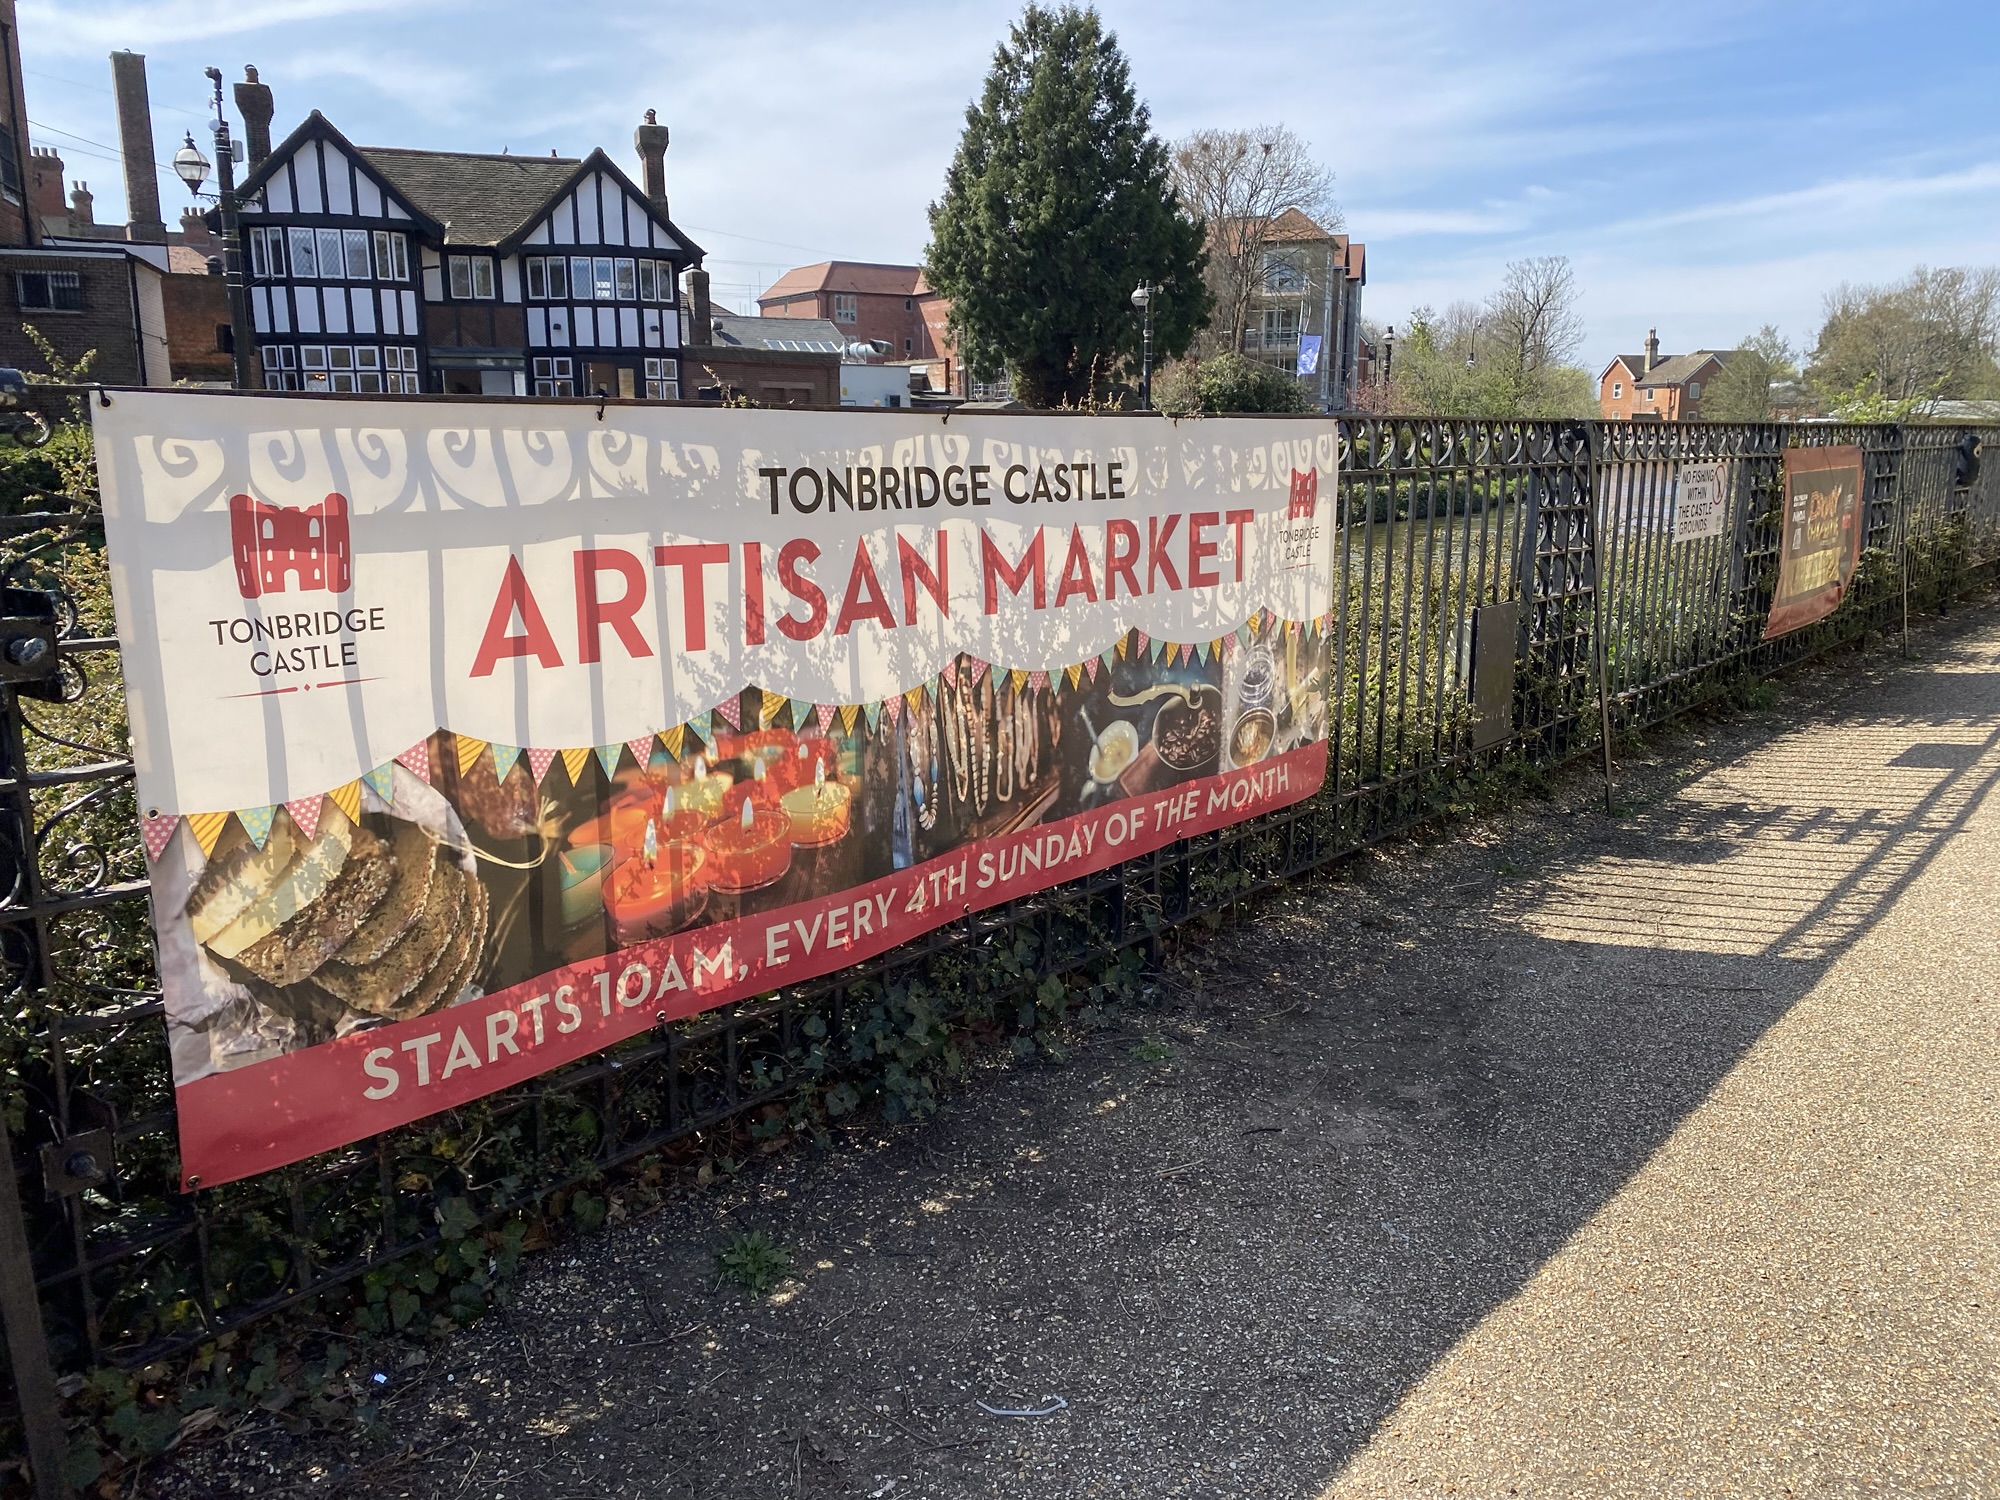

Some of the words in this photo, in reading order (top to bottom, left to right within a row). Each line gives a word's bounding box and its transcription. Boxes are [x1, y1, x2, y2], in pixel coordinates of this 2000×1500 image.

[758, 464, 991, 515] TONBRIDGE
[1003, 462, 1126, 505] CASTLE
[1682, 470, 1691, 484] NO
[1692, 469, 1714, 484] FISHING
[1687, 486, 1707, 501] WITHIN
[1679, 504, 1690, 519] THE
[1690, 501, 1713, 518] CASTLE
[1279, 526, 1320, 544] TONBRIDGE
[1285, 544, 1311, 560] CASTLE
[469, 529, 949, 678] ARTISAN
[980, 508, 1255, 616] MARKET
[208, 607, 386, 646] TONBRIDGE
[250, 641, 358, 677] CASTLE
[362, 985, 582, 1101] STARTS
[593, 936, 749, 1017] 10AM,
[765, 886, 897, 968] EVERY
[904, 860, 967, 914] 4TH
[976, 819, 1099, 889] SUNDAY
[1104, 805, 1145, 847] OF
[1153, 789, 1200, 832] THE
[1206, 763, 1290, 816] MONTH
